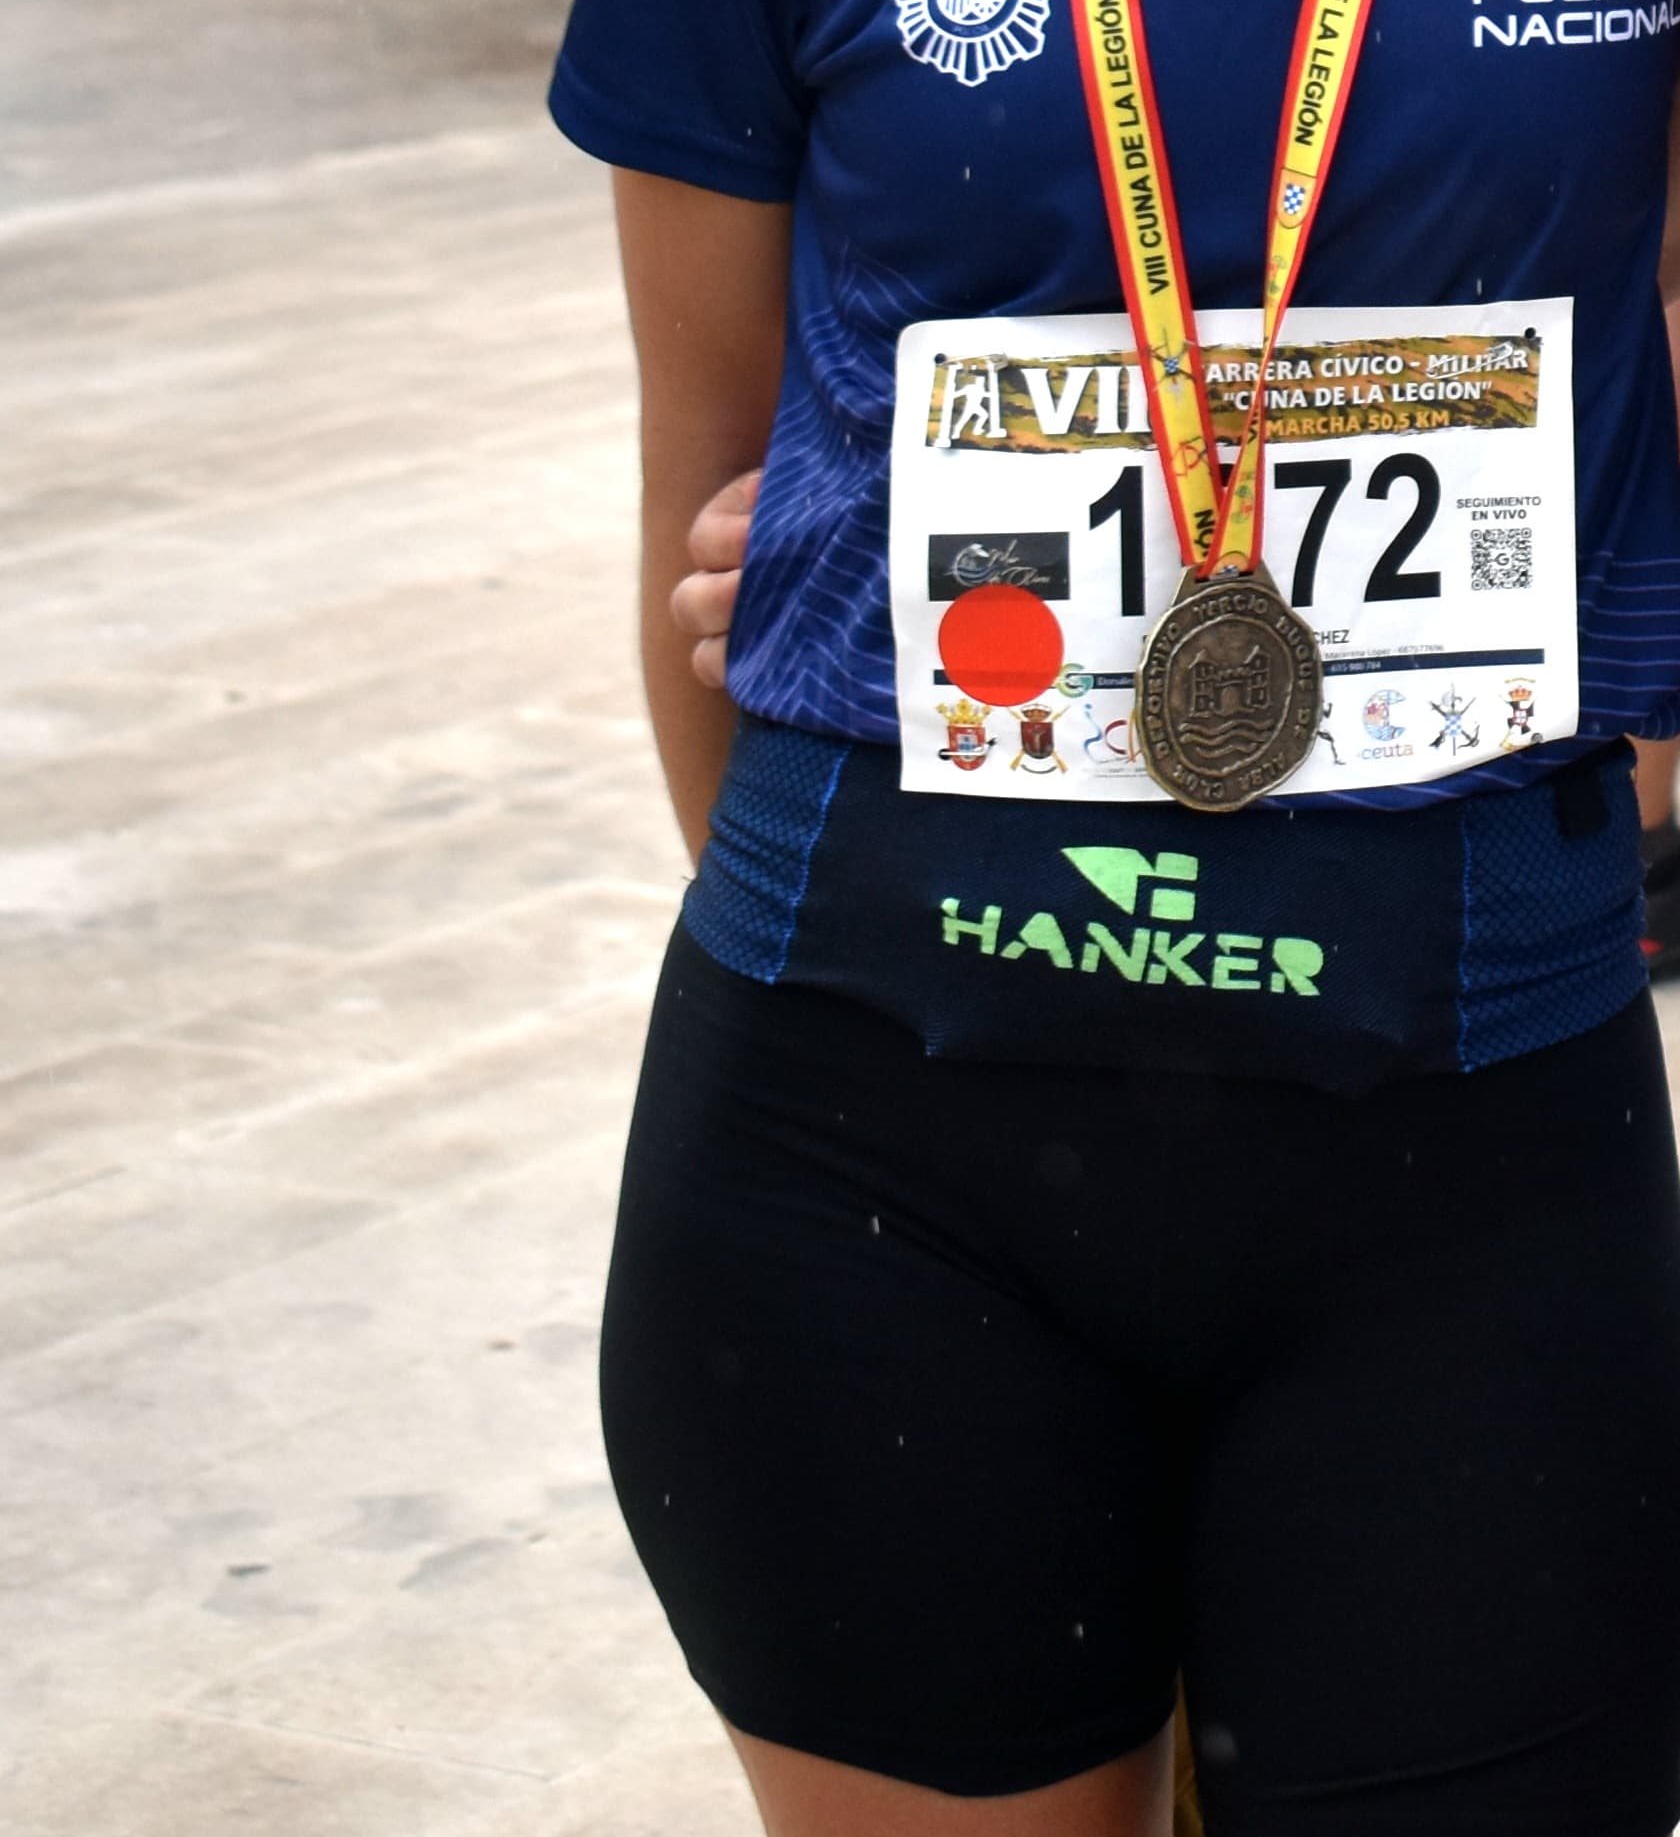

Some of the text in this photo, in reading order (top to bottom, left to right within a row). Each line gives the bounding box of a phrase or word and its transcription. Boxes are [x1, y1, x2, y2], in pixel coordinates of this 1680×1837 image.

[1316, 8, 1344, 41] LA
[1114, 92, 1141, 128] LA
[1294, 46, 1335, 147] LEGIÓN
[1121, 133, 1149, 170] DE
[1130, 175, 1162, 248] CUNA
[1144, 254, 1170, 296] VIII
[1020, 366, 1153, 436] VII
[1203, 359, 1314, 384] ARRERA
[1320, 352, 1405, 379] CÍVICO
[1427, 347, 1529, 377] MILITAR
[1315, 385, 1345, 407] DE
[1352, 384, 1387, 405] LA
[1265, 412, 1361, 436] MARCHA
[1368, 412, 1411, 435] 50,5
[1415, 410, 1450, 429] KM
[1456, 495, 1542, 509] SEGUIMIENTO
[1471, 509, 1527, 521] EN VIVO
[1089, 452, 1442, 617] 172
[1313, 629, 1350, 645] CHEZ
[1360, 742, 1414, 760] ceuta
[940, 897, 1325, 997] HANKER
